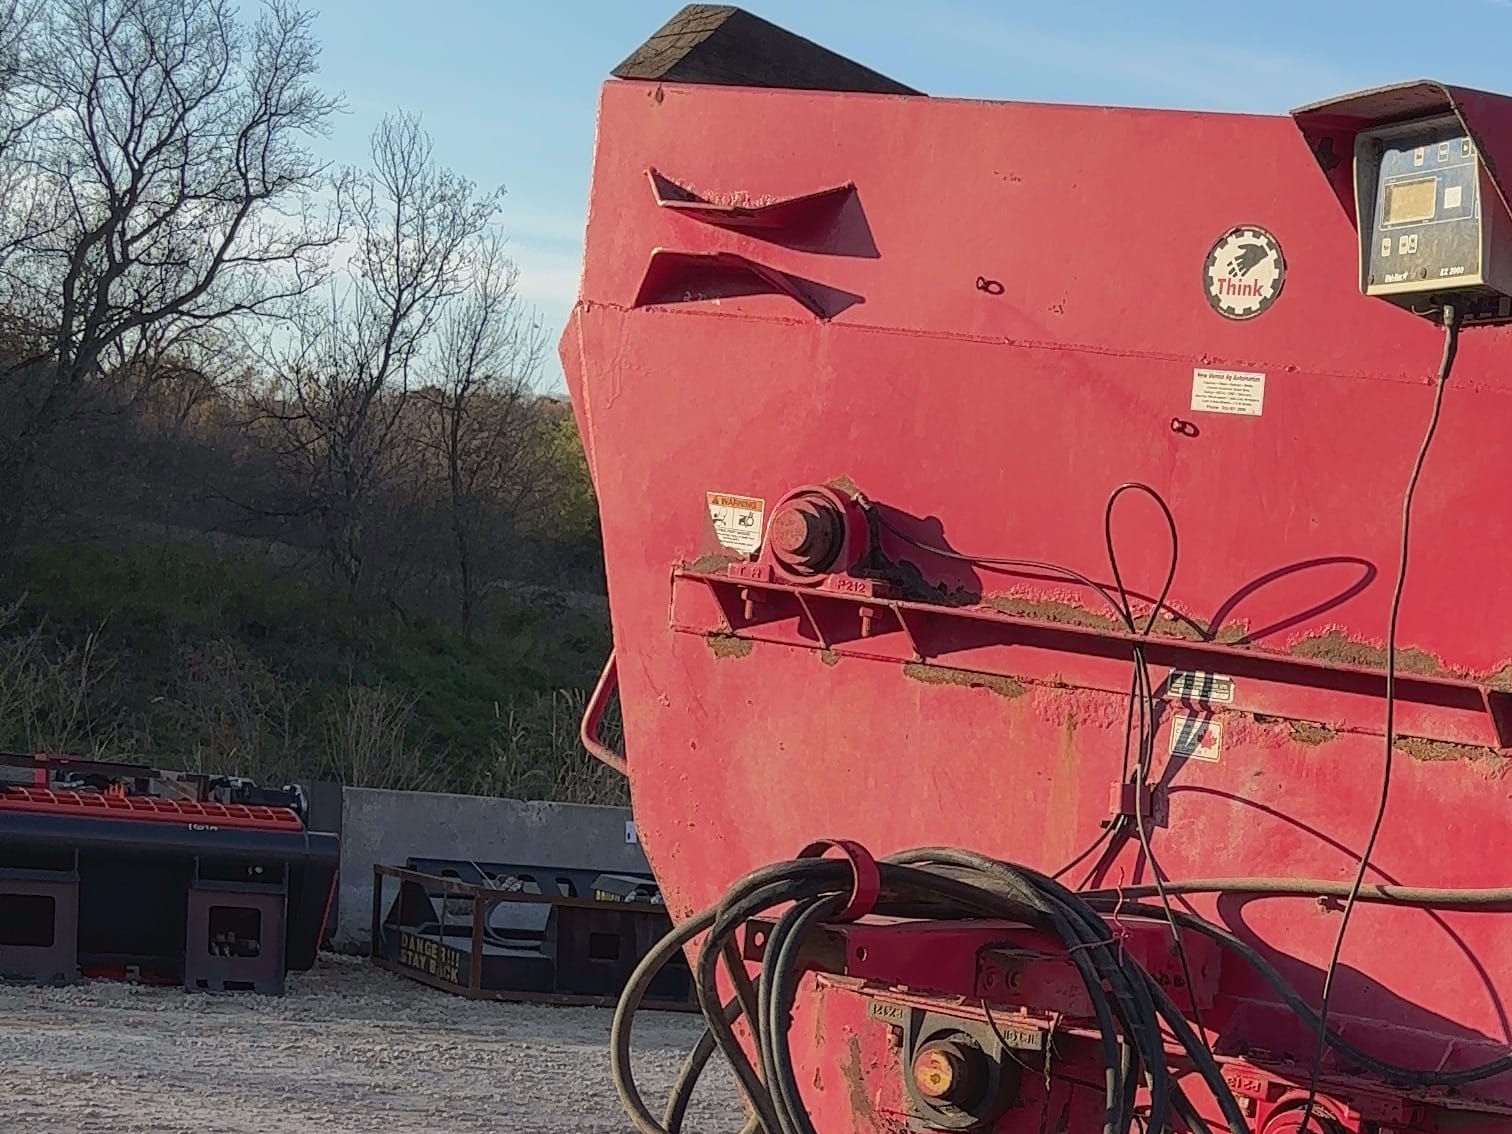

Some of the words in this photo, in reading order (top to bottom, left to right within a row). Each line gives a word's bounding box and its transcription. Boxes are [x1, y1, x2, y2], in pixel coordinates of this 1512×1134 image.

[1217, 277, 1264, 297] Think
[721, 497, 757, 509] WARNING
[400, 949, 427, 969] STAY
[429, 959, 458, 983] BACK
